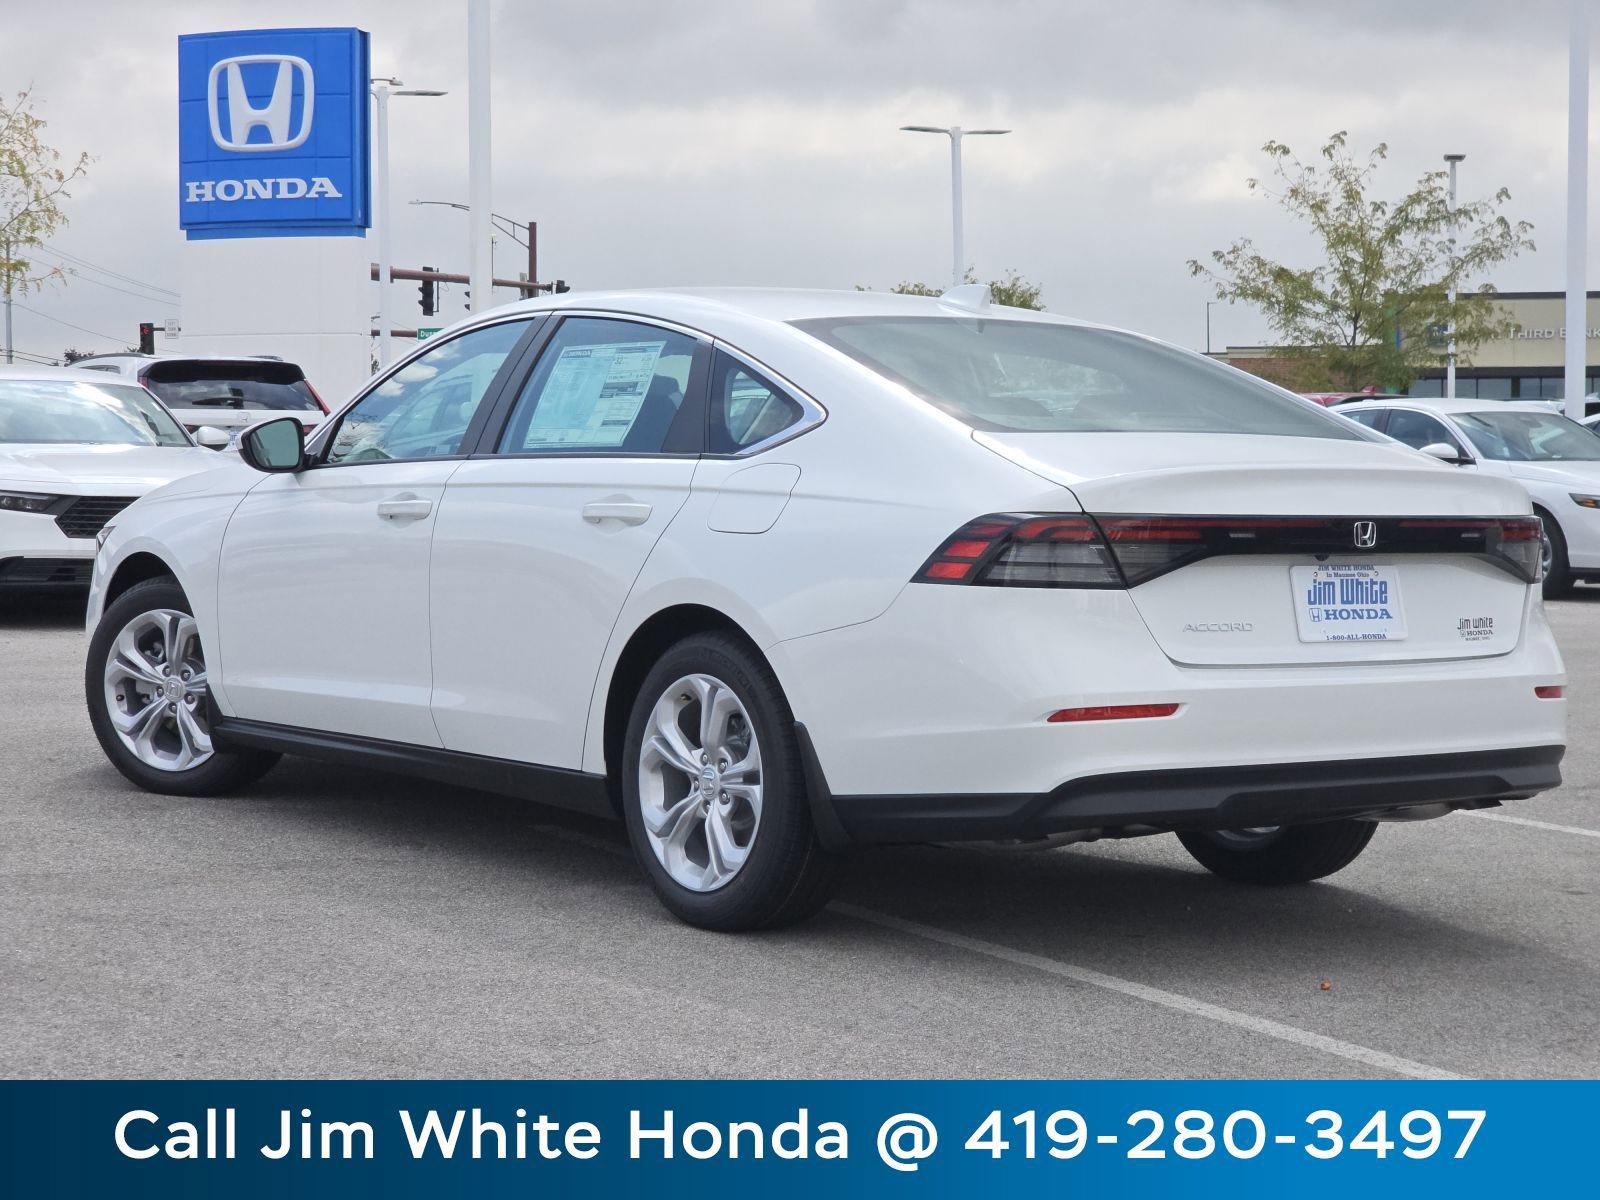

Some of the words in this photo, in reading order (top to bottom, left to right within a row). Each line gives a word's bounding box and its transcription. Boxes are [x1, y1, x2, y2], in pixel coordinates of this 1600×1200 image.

[185, 177, 343, 203] HONDA
[1510, 327, 1555, 339] THIRD
[1308, 579, 1336, 605] Jim
[1340, 578, 1388, 605] White
[1324, 608, 1393, 620] HONDA
[1182, 622, 1254, 633] ACCORD
[1457, 617, 1471, 630] Jim
[1472, 616, 1493, 629] White
